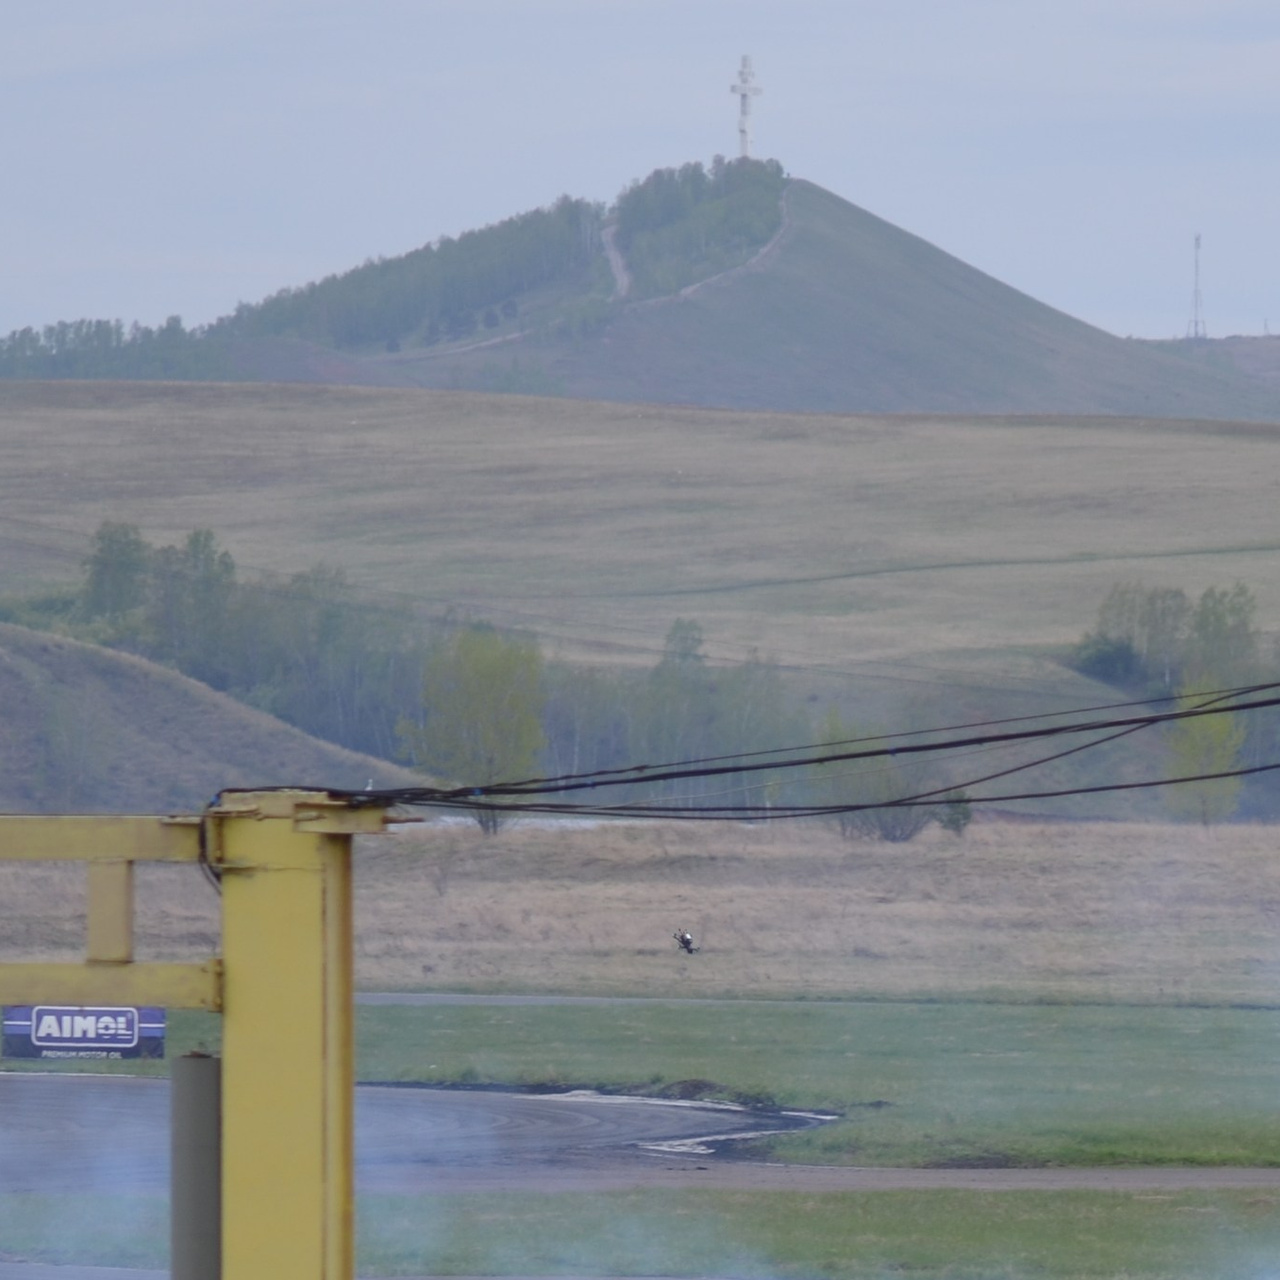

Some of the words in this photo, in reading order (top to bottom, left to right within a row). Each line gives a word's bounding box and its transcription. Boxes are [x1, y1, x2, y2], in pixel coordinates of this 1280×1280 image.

[37, 1015, 133, 1039] AIMOL
[41, 1050, 77, 1058] PREMIUM
[78, 1051, 107, 1059] MOTOR
[108, 1051, 122, 1059] OIL
